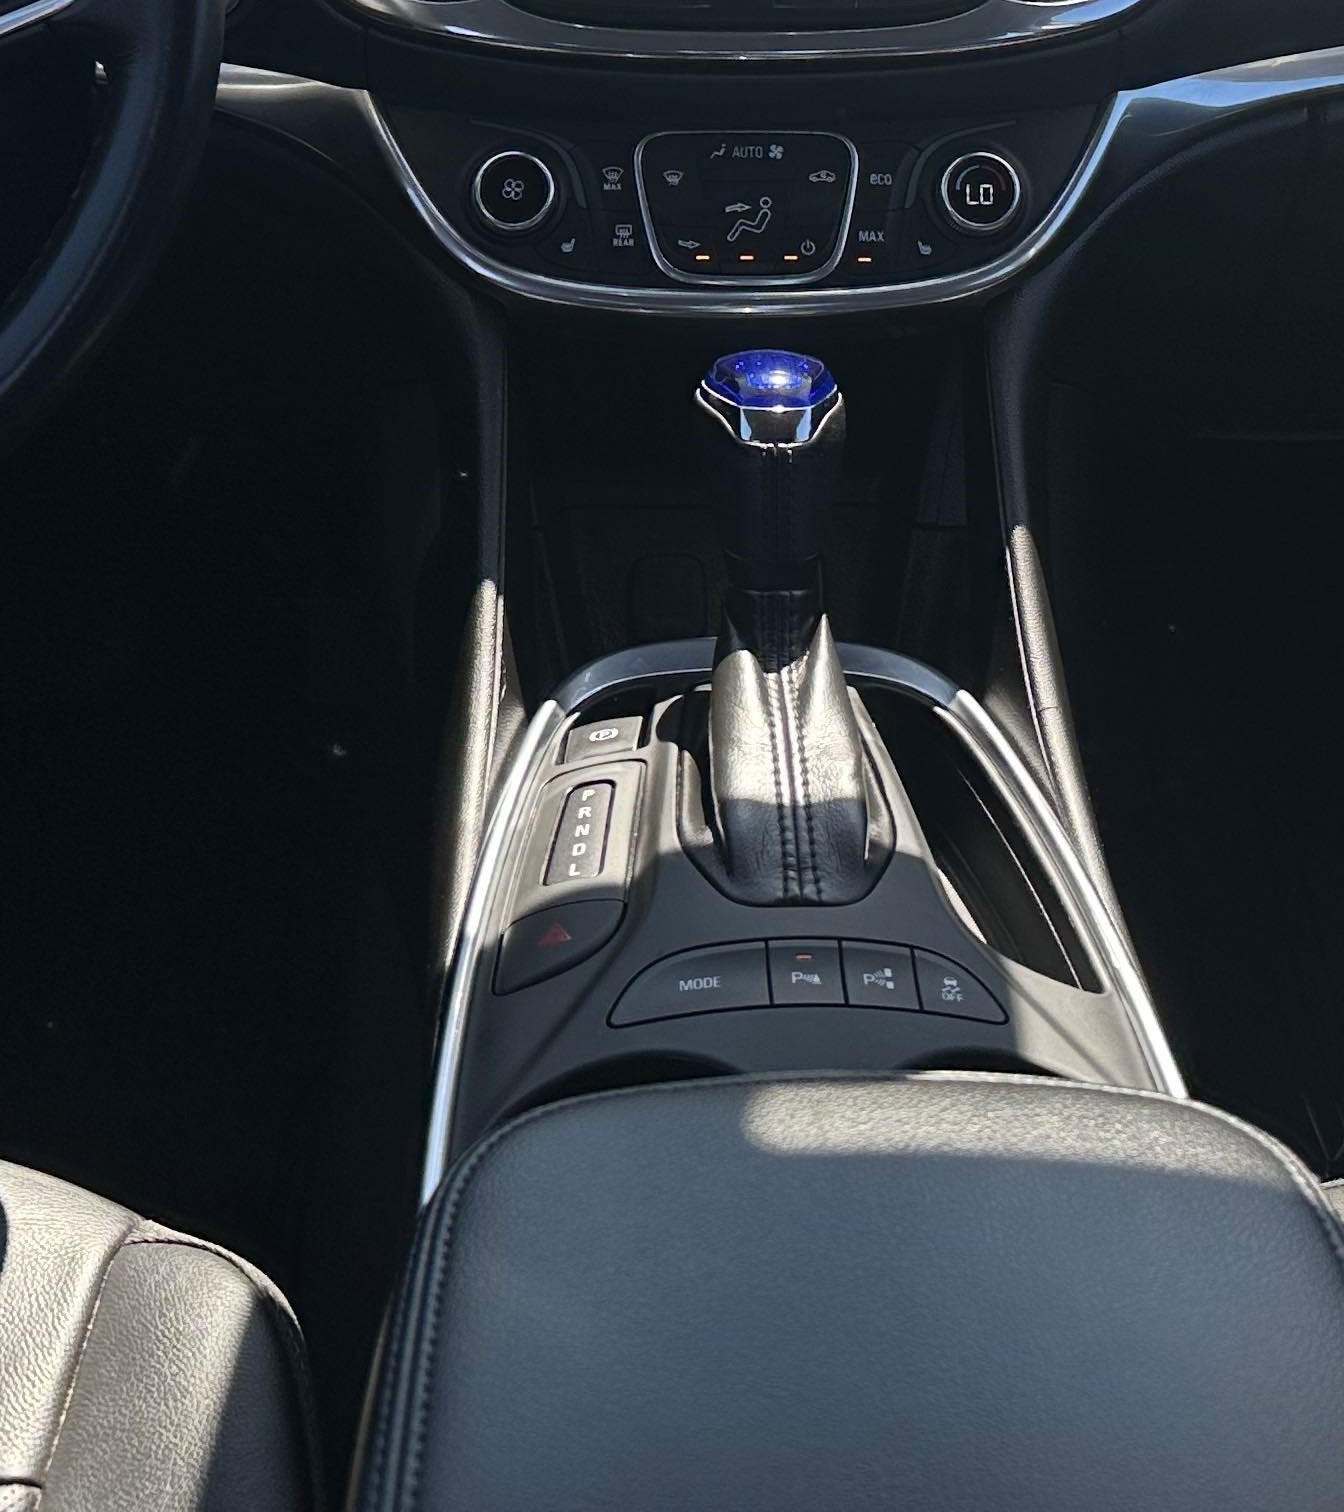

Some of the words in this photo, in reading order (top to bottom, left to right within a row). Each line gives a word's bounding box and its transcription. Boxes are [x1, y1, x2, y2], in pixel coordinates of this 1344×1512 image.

[732, 145, 763, 159] AUTO
[613, 238, 634, 247] REAR
[858, 230, 885, 242] MAX
[581, 789, 596, 802] P
[577, 806, 593, 819] R
[574, 824, 591, 838] N
[571, 842, 587, 857] D
[568, 863, 581, 877] L
[678, 975, 721, 992] MODE
[941, 991, 964, 1002] OFF
